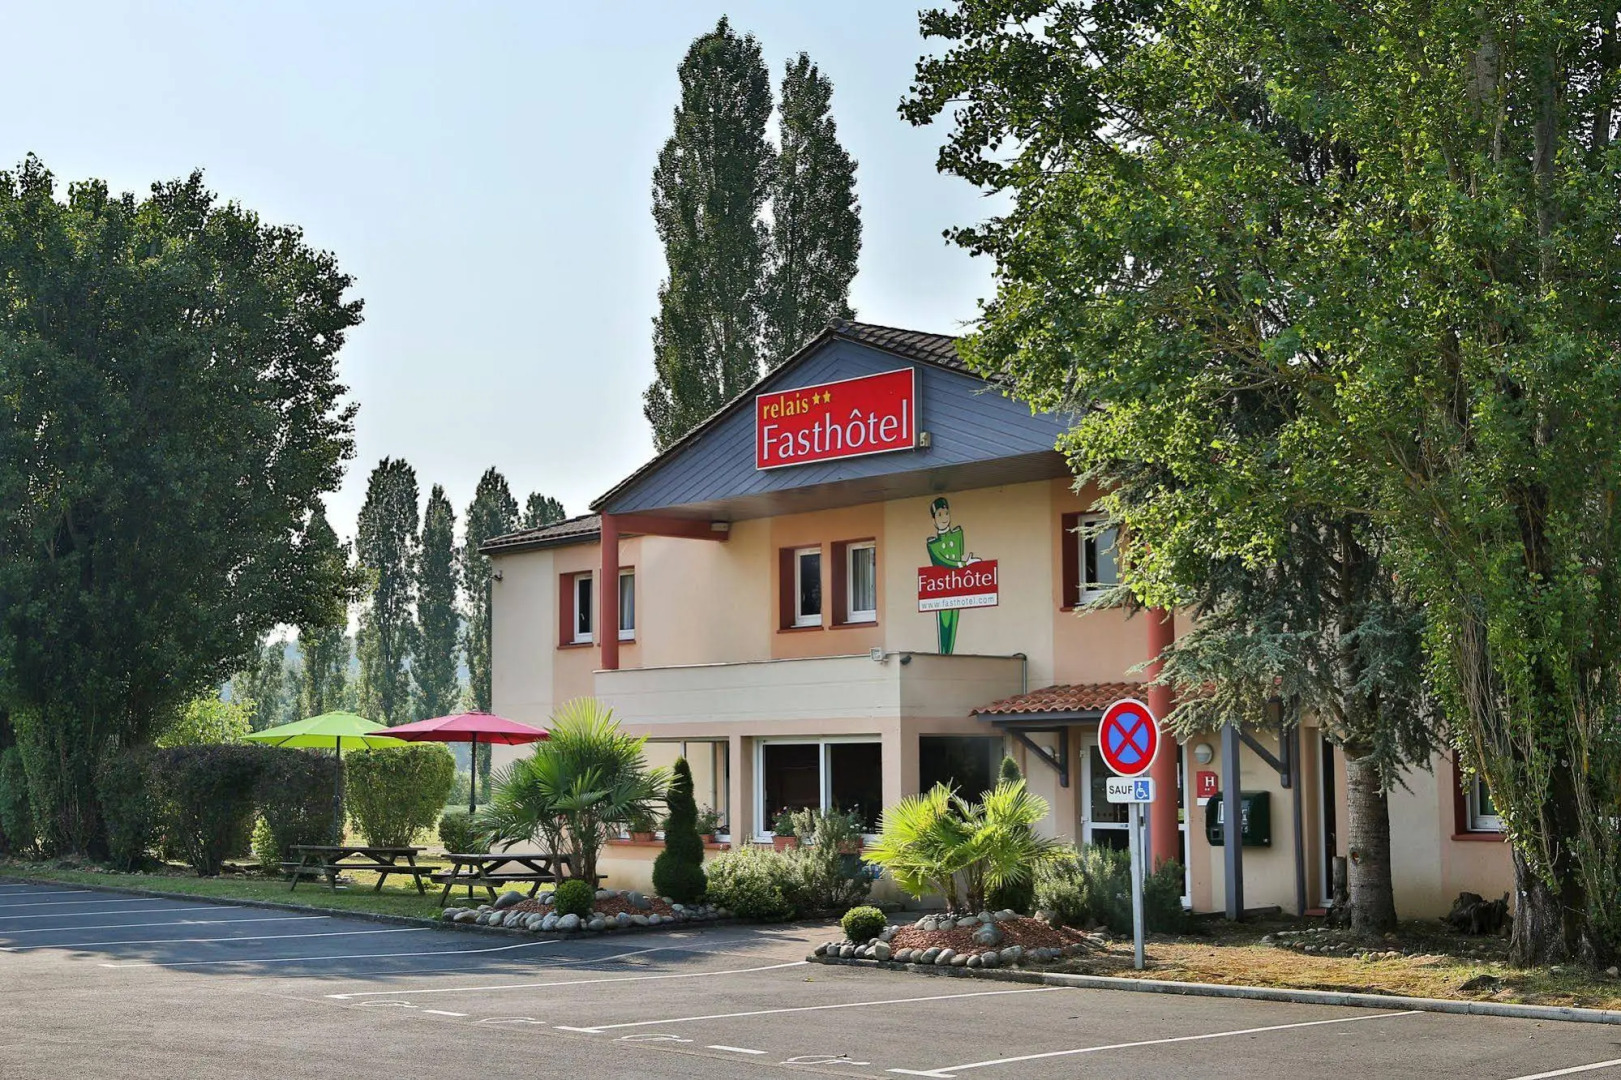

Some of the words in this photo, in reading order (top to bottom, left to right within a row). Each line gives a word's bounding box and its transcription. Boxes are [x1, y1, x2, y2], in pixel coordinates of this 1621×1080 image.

[763, 393, 809, 420] relais
[763, 399, 908, 460] Fasthôtel
[918, 567, 997, 592] Fasthôtel
[921, 596, 995, 609] www.fasthotel.com
[1109, 785, 1133, 795] SAUF
[1205, 776, 1215, 787] H
